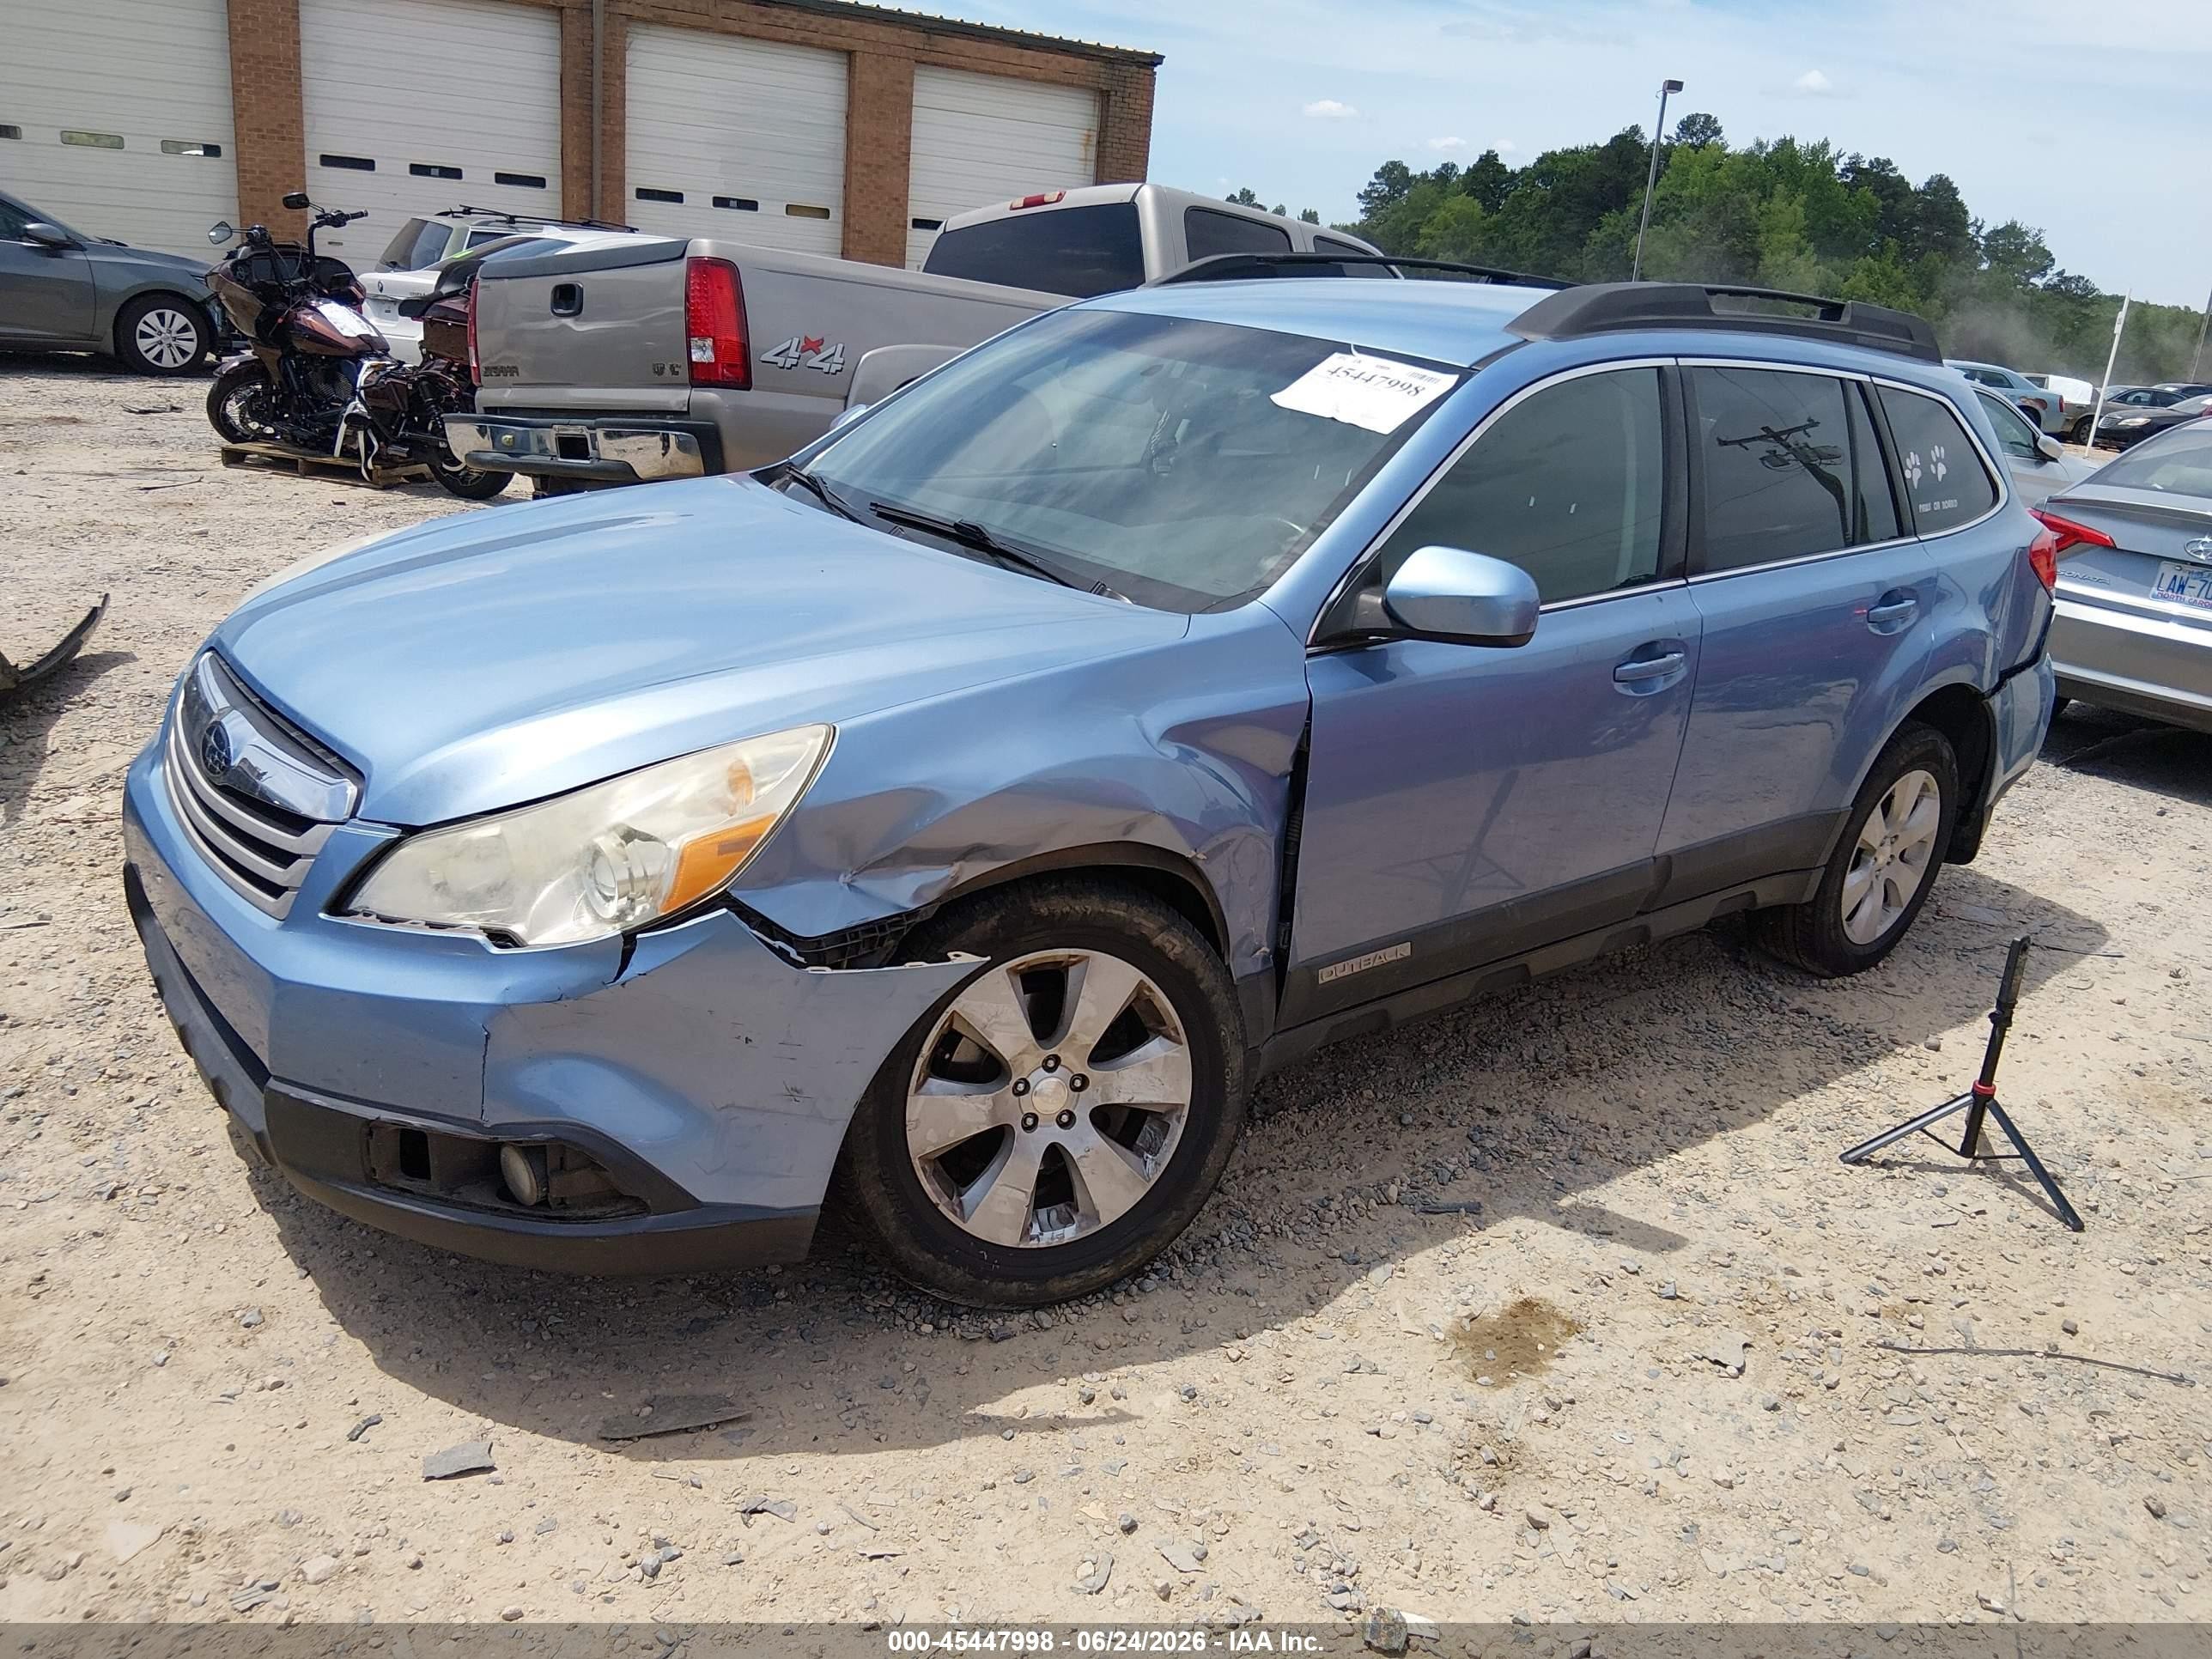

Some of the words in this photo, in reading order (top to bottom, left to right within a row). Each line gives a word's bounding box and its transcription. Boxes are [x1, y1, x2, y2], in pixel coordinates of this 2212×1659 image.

[1328, 366, 1425, 397] 45447998
[2157, 592, 2185, 602] NORTH
[1320, 944, 1410, 982] OUTBACK
